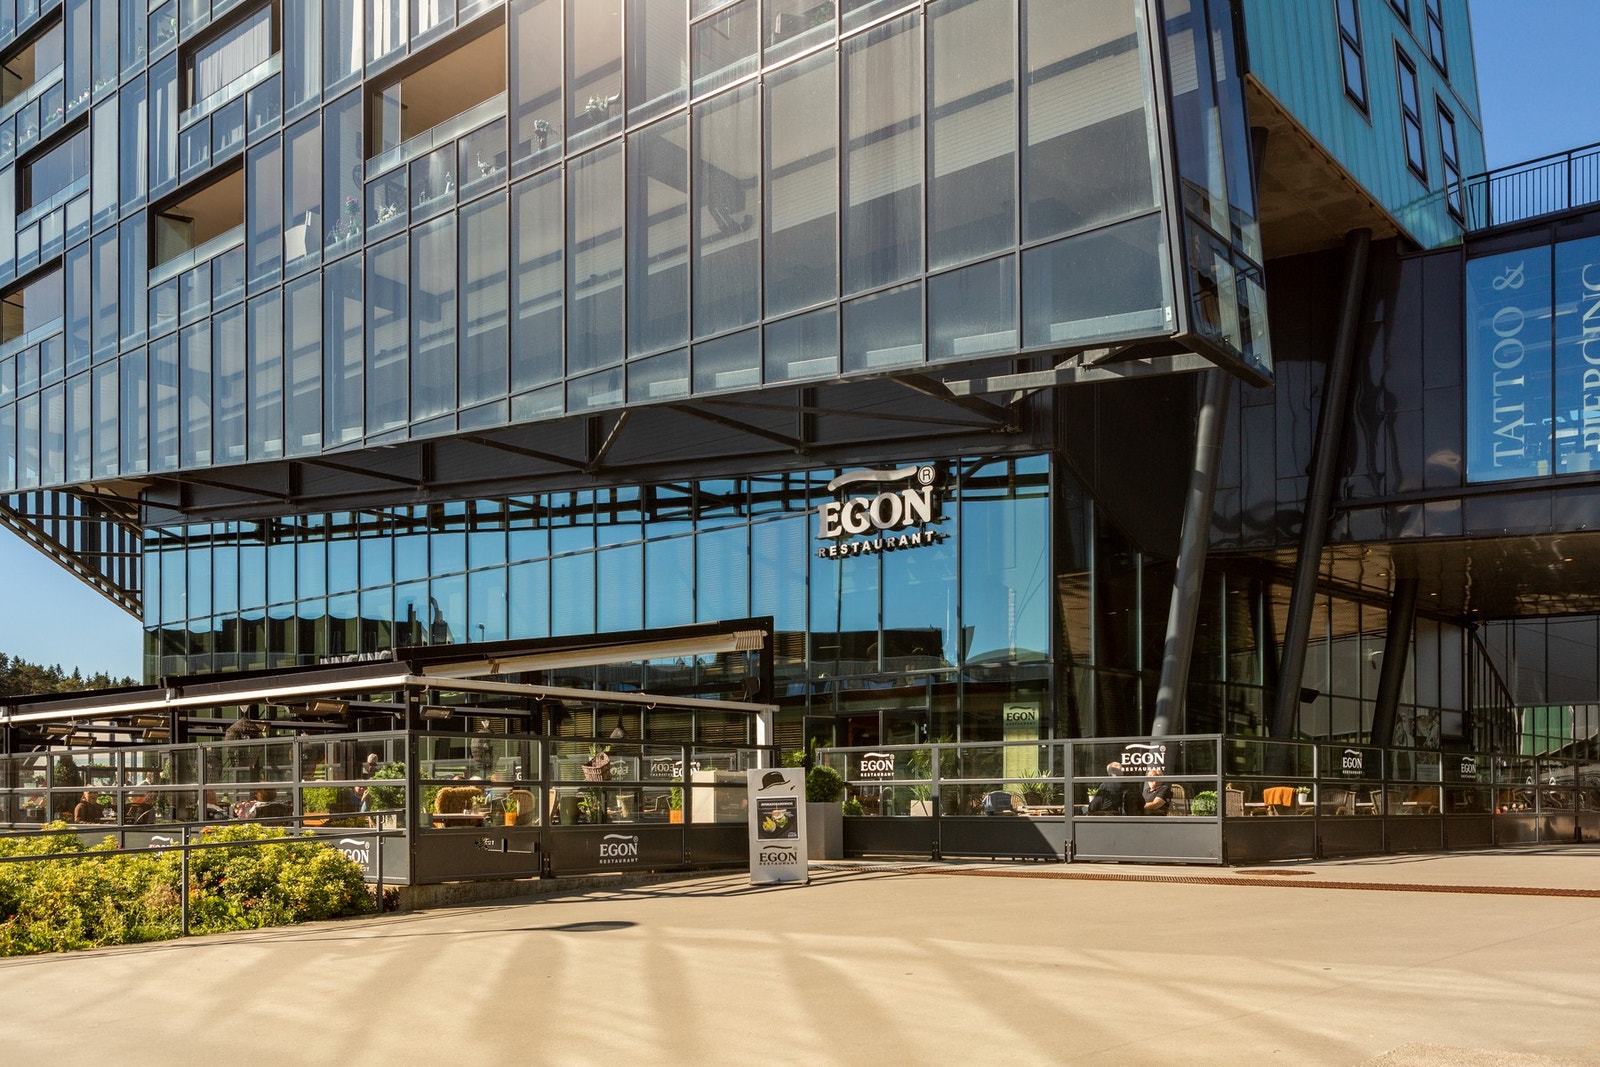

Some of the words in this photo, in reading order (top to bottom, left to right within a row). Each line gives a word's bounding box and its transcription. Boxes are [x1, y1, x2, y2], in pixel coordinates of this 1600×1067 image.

[1492, 261, 1525, 290] &
[1493, 306, 1525, 467] TATTOO
[817, 486, 934, 539] EGON
[818, 530, 935, 558] RESTAURANT
[1006, 712, 1035, 721] EGON
[860, 759, 894, 771] EGON
[1121, 752, 1165, 765] EGON
[1342, 756, 1363, 769] EGON
[337, 848, 369, 864] GON
[599, 843, 638, 857] EGON
[759, 852, 798, 862] EGON
